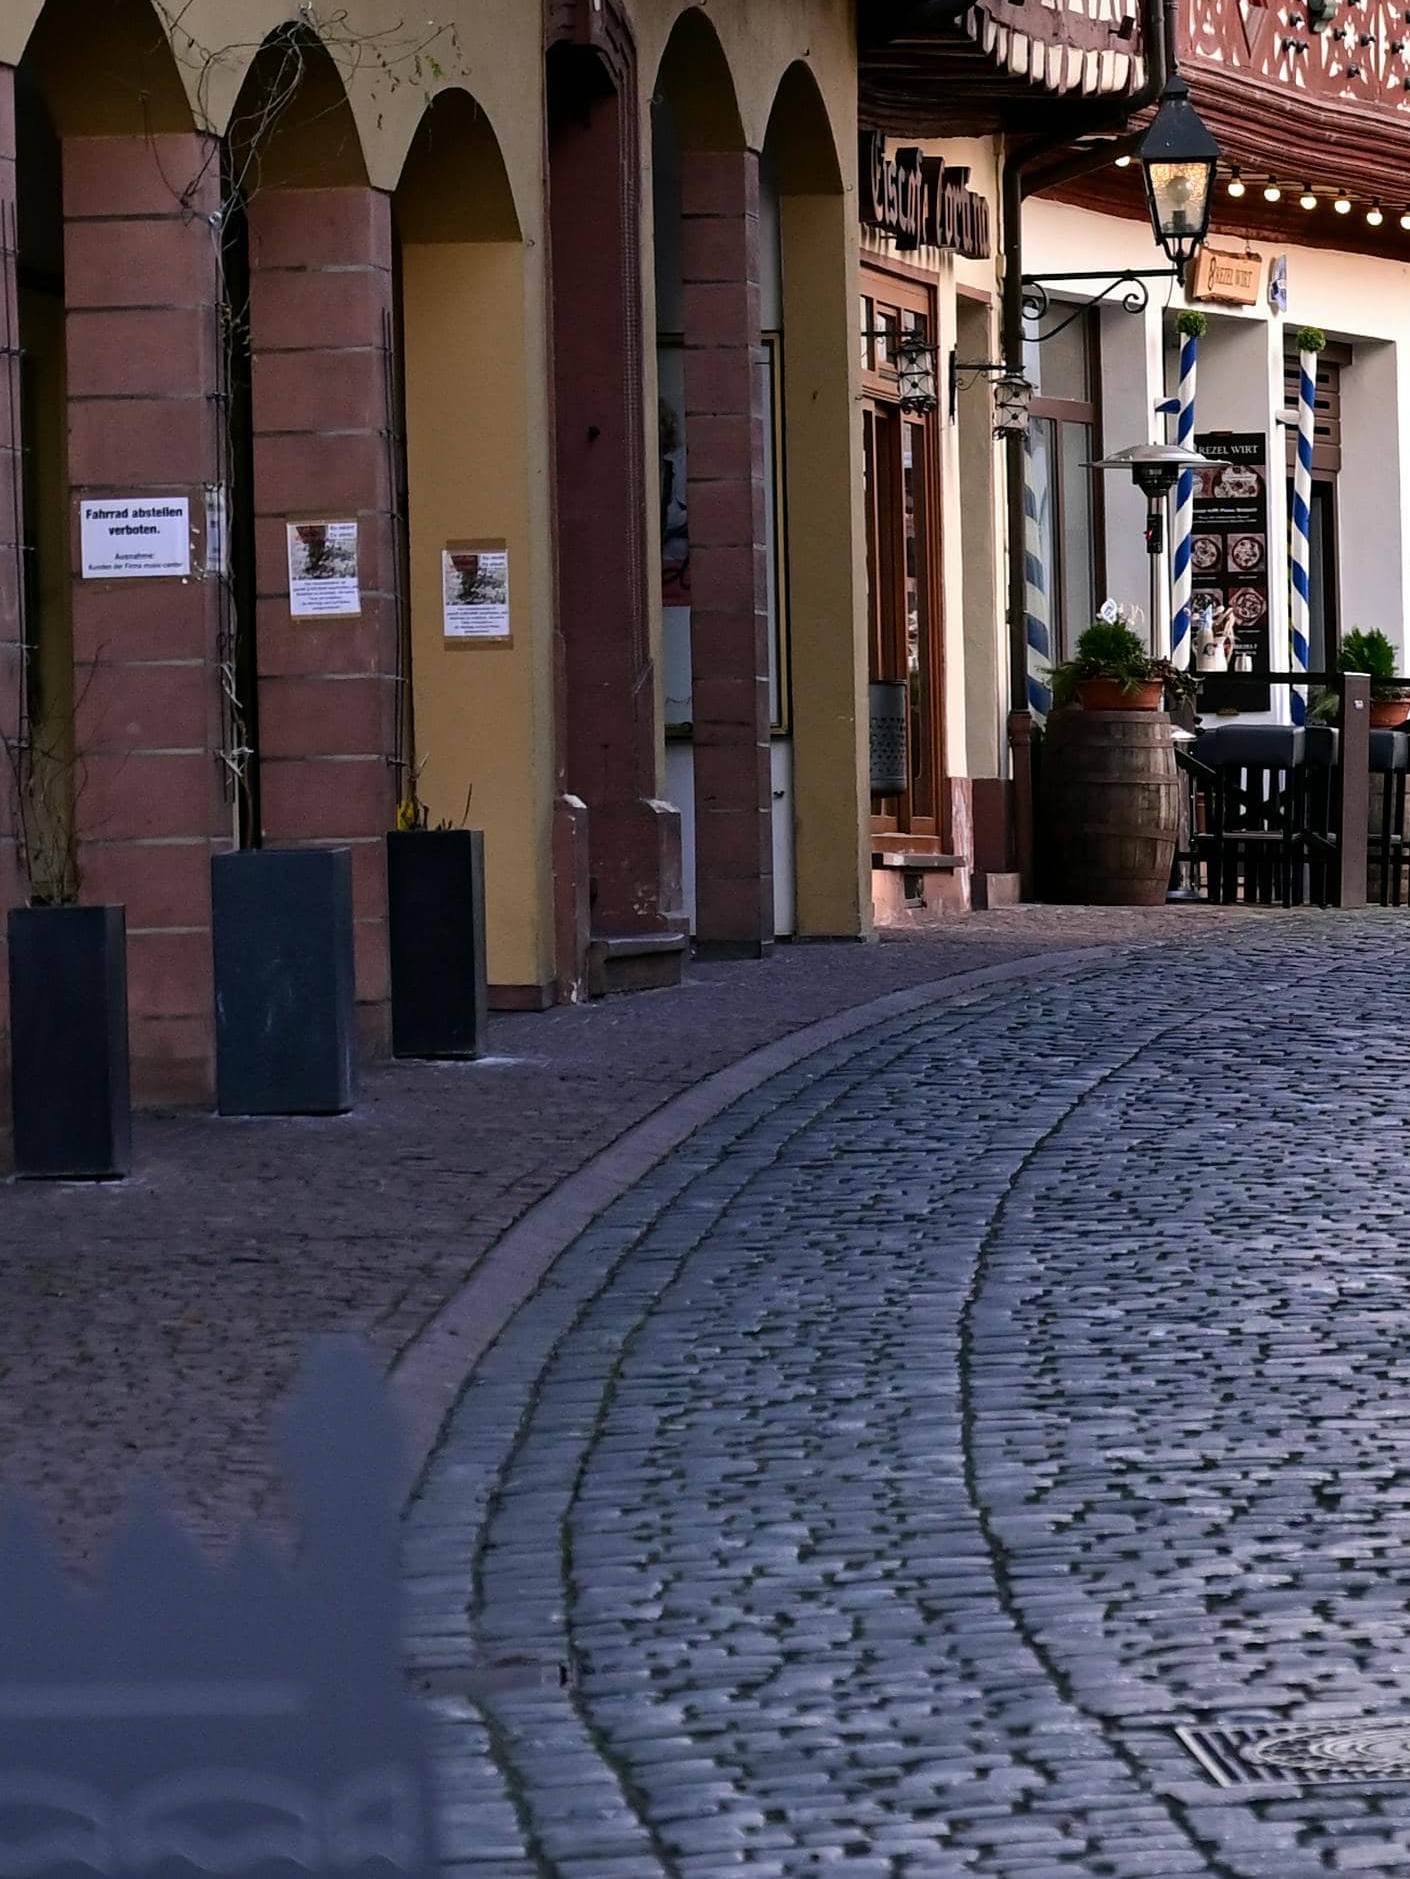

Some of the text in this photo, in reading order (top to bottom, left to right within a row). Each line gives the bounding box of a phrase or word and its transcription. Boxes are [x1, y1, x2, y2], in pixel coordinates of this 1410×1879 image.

[1230, 444, 1259, 455] WIRT
[86, 507, 183, 519] Fahrrad abstellen
[109, 525, 160, 535] verboten.
